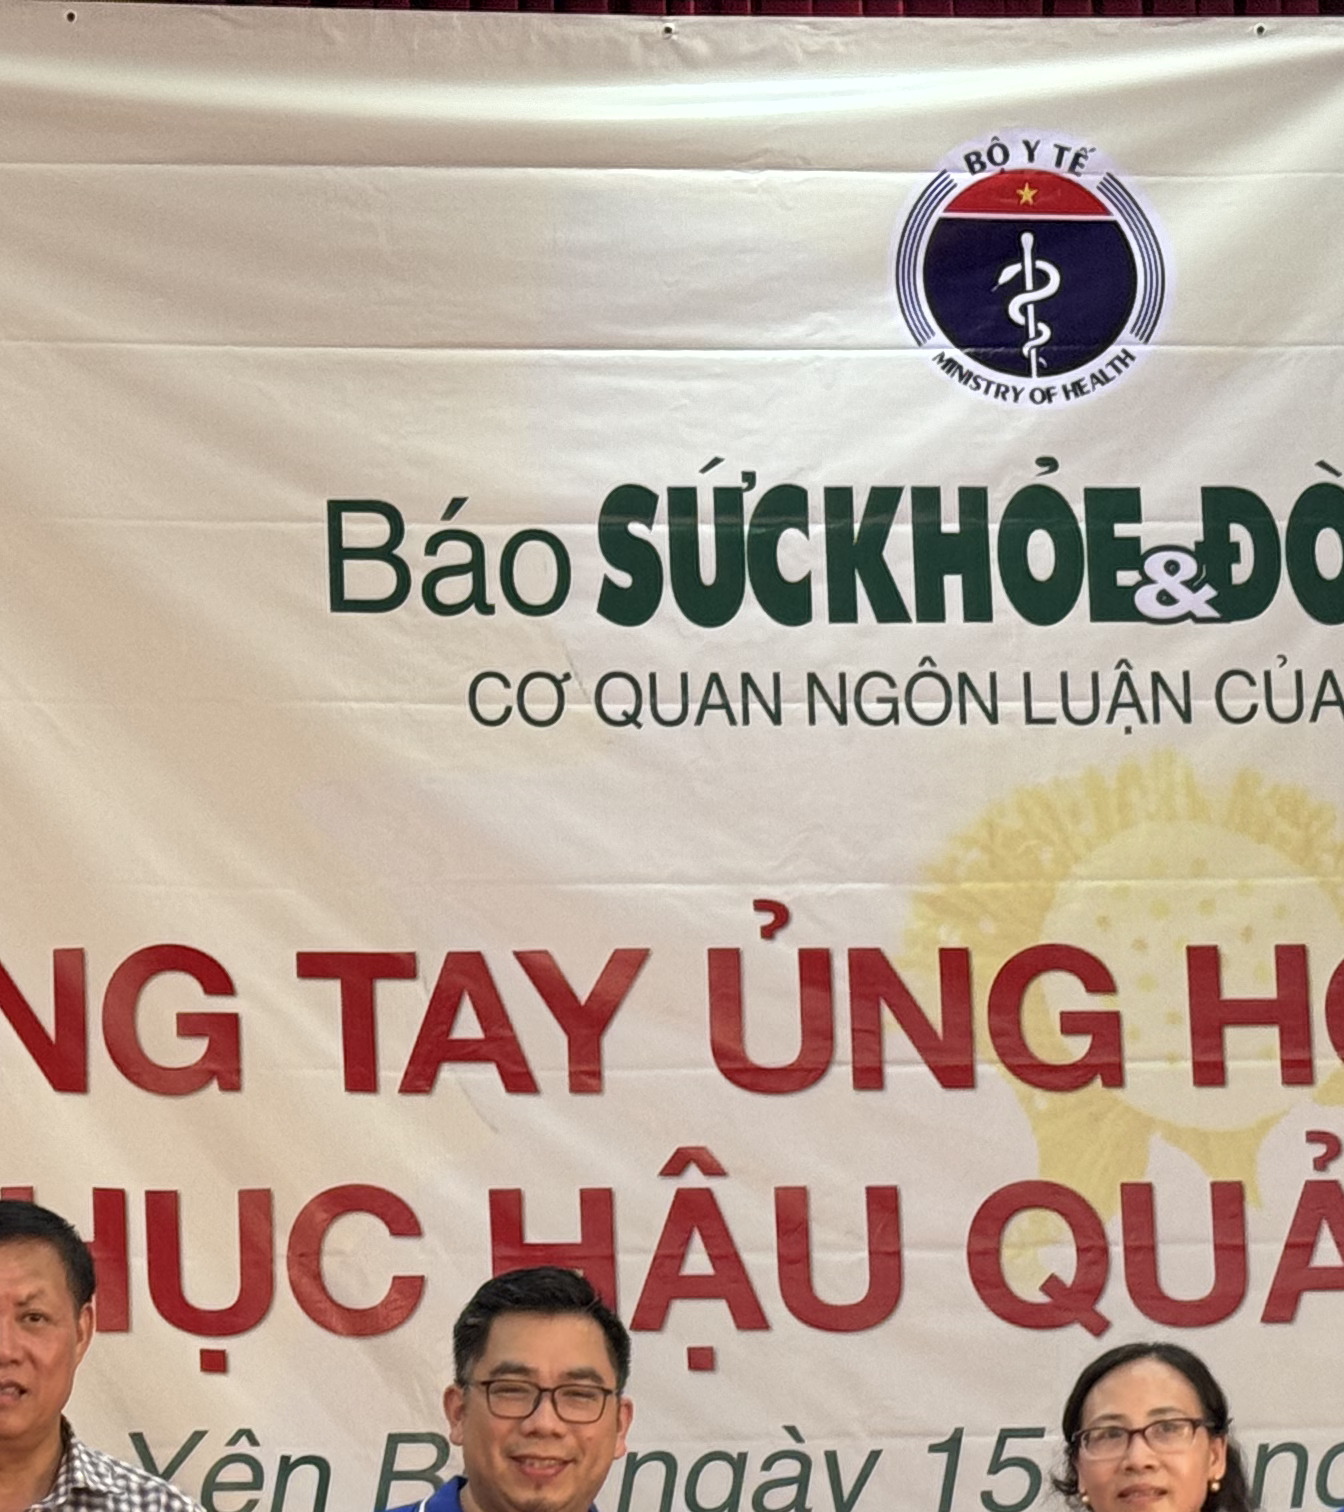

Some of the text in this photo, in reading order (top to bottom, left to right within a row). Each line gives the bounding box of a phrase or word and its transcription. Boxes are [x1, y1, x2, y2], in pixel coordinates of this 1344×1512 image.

[1022, 139, 1041, 163] Y
[1053, 144, 1097, 177] TẾ
[932, 347, 1136, 406] MINISTRY OF HEALTH
[325, 496, 572, 618] Báo
[467, 670, 572, 728] CƠ
[594, 671, 783, 730] QUAN
[808, 656, 999, 727] NGÔN
[1023, 658, 1193, 735] LUẬN
[296, 946, 652, 1097] TAY
[706, 898, 1126, 1095] ỦNG
[488, 1146, 905, 1372] HẬU
